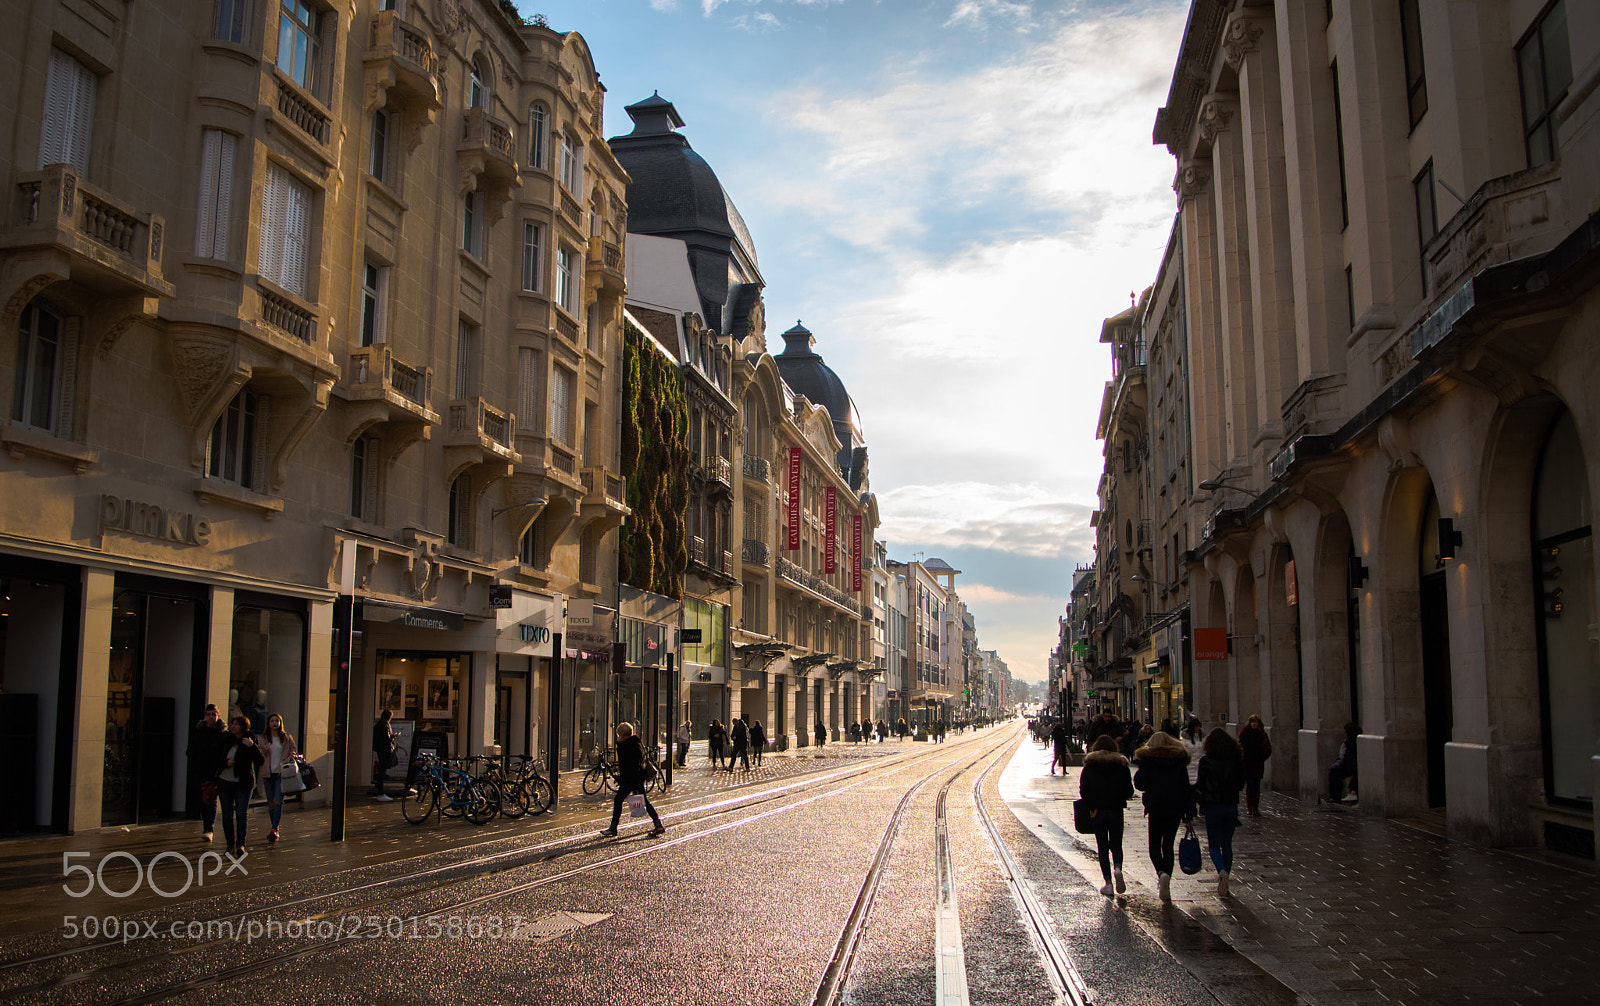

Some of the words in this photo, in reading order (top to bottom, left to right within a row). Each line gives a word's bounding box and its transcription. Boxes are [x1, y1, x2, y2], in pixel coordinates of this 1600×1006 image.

[790, 452, 800, 500] LAFAYETTE
[96, 493, 212, 546] pimkie
[790, 502, 798, 545] GALERIES
[827, 491, 835, 531] LAFAYETTE
[826, 531, 834, 569] GALERIES
[519, 623, 550, 644] TEXTO
